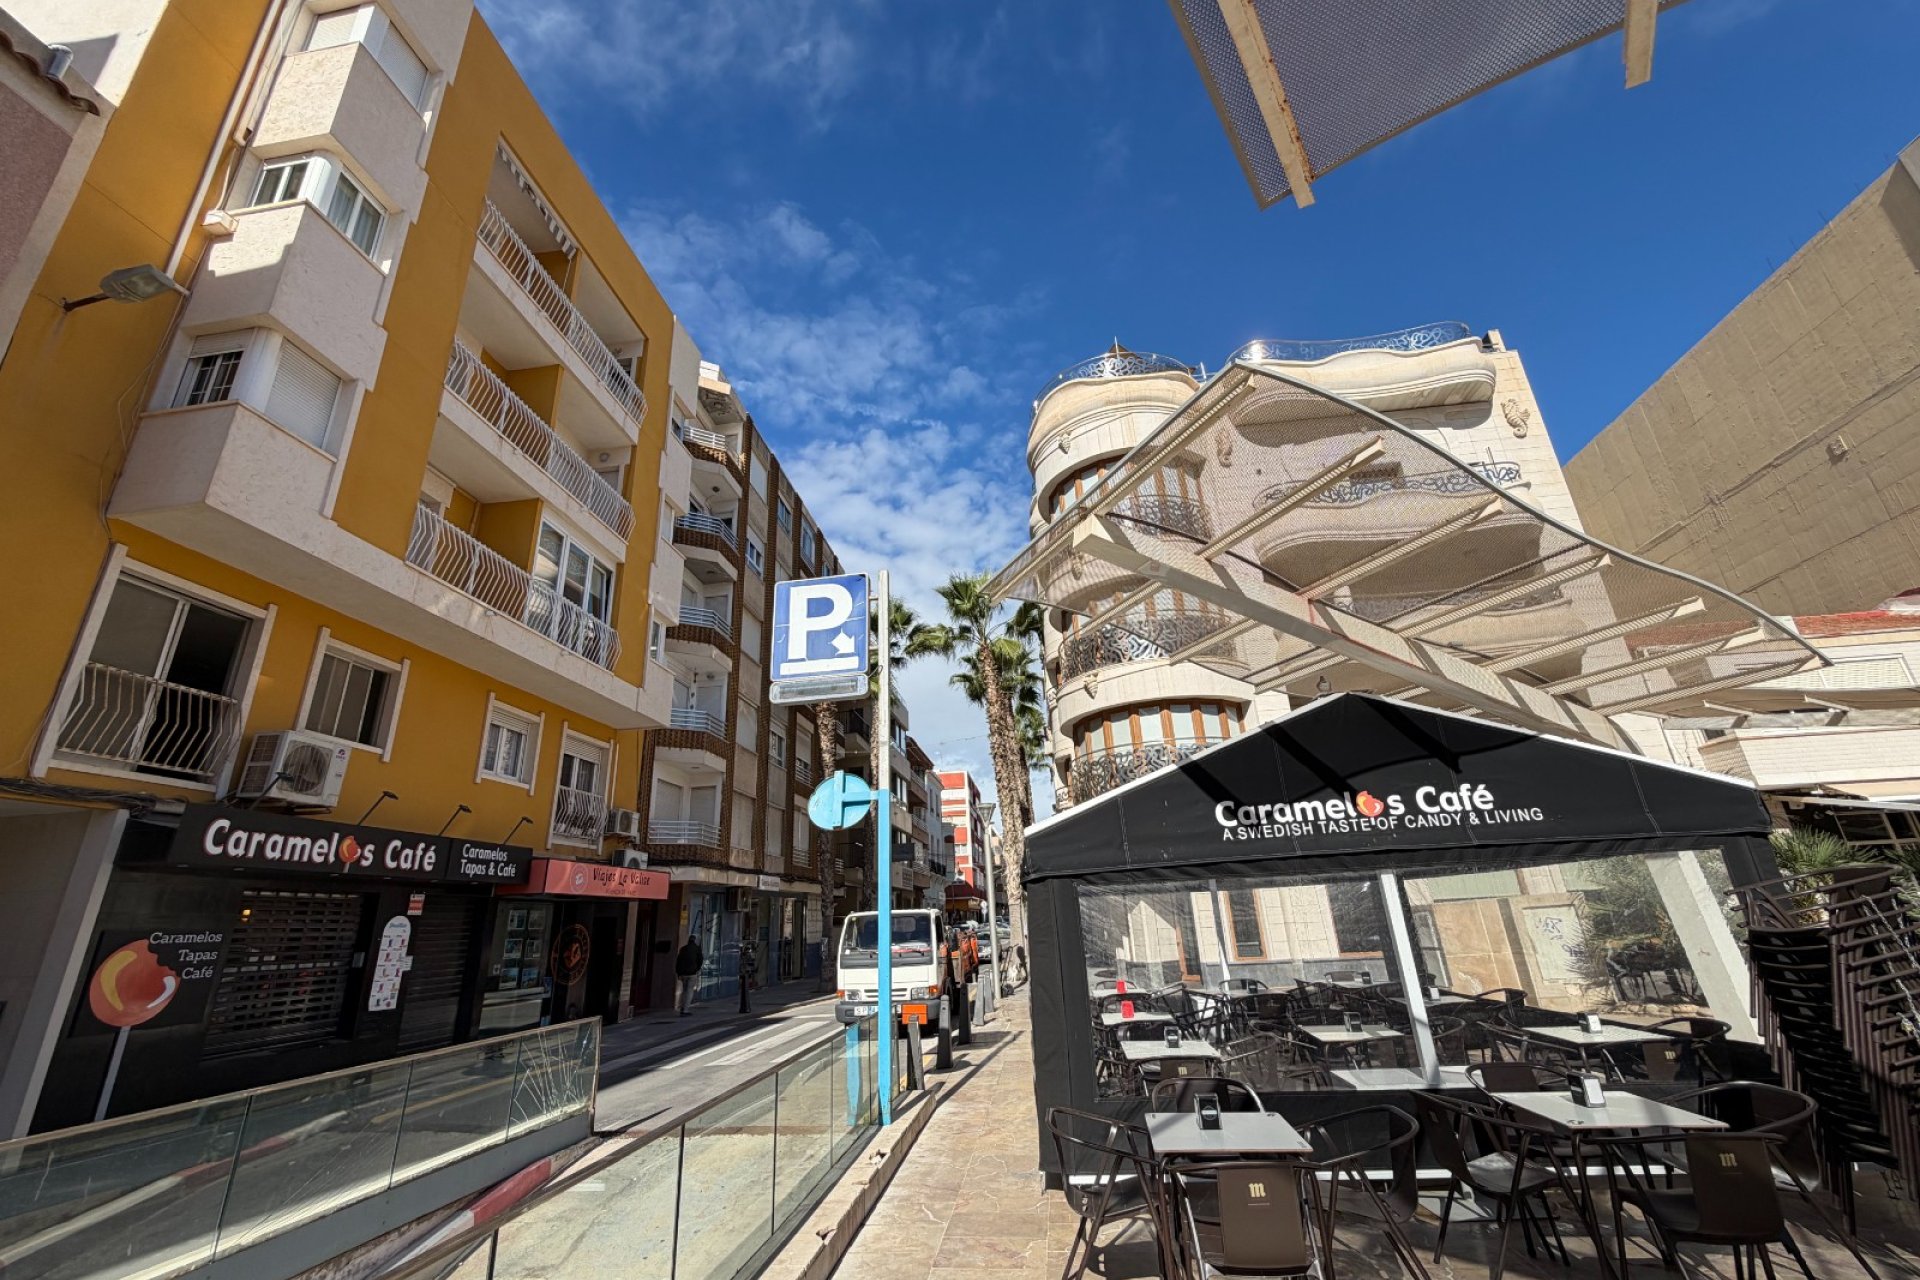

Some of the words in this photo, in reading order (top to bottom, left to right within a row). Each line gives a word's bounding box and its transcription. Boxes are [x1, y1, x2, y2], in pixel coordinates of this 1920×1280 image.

[787, 584, 853, 661] P
[1415, 783, 1495, 814] Café
[1223, 828, 1234, 841] A
[1237, 822, 1314, 841] SWEDISH
[1317, 818, 1371, 834] TASTE
[1376, 816, 1398, 830] OF
[1404, 812, 1462, 828] CANDY
[1469, 811, 1480, 826] &
[1484, 807, 1544, 825] LIVING
[384, 839, 437, 872] Café
[462, 843, 508, 862] Caramelos
[460, 859, 486, 878] Tapas
[488, 861, 495, 876] &
[497, 863, 516, 877] Café
[149, 931, 223, 945] Caramelos
[178, 949, 218, 964] Tapas
[182, 966, 214, 980] Café
[1718, 1152, 1738, 1168] m
[1248, 1182, 1266, 1198] m
